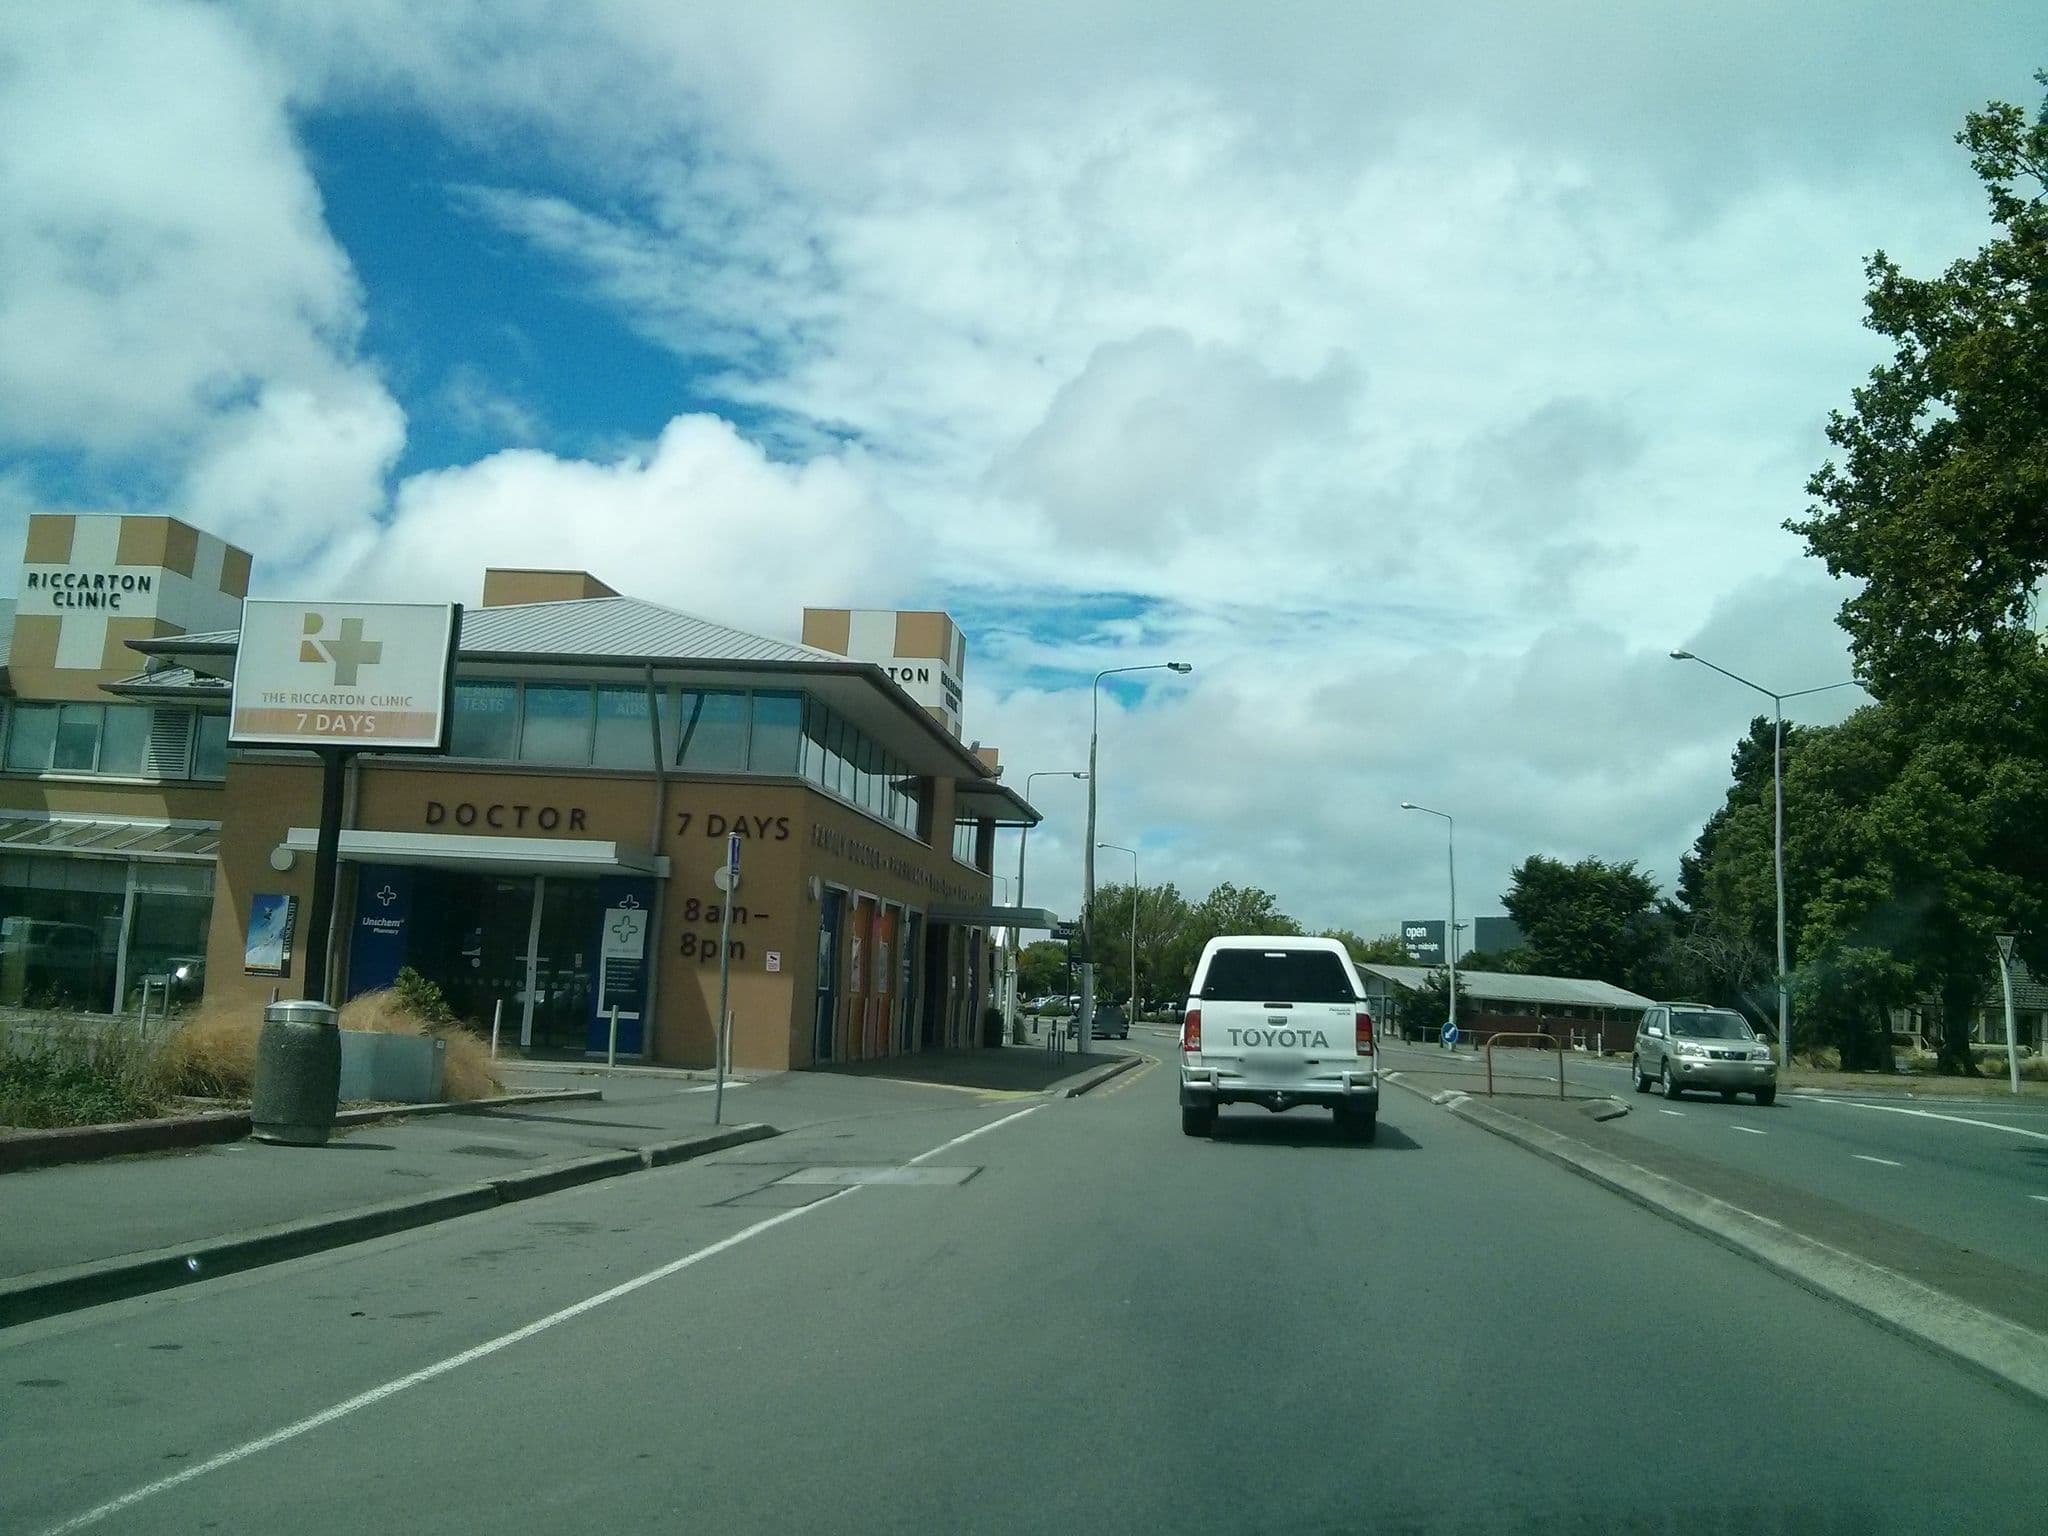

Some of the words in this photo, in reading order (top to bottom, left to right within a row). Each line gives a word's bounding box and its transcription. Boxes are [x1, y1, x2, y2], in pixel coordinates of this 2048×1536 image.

[27, 572, 151, 592] RICCARTON
[53, 591, 121, 609] CLINIC
[881, 667, 930, 683] TON
[262, 692, 286, 703] THE
[290, 693, 365, 706] RICCARTON
[370, 695, 413, 707] CLINIC
[296, 713, 308, 731] 7
[315, 714, 376, 733] DAYS
[425, 801, 587, 831] DOCTOR
[677, 812, 692, 836] 7
[706, 813, 790, 841] DAYS
[1405, 927, 1427, 940] open
[1227, 1028, 1330, 1048] TOYOTA
